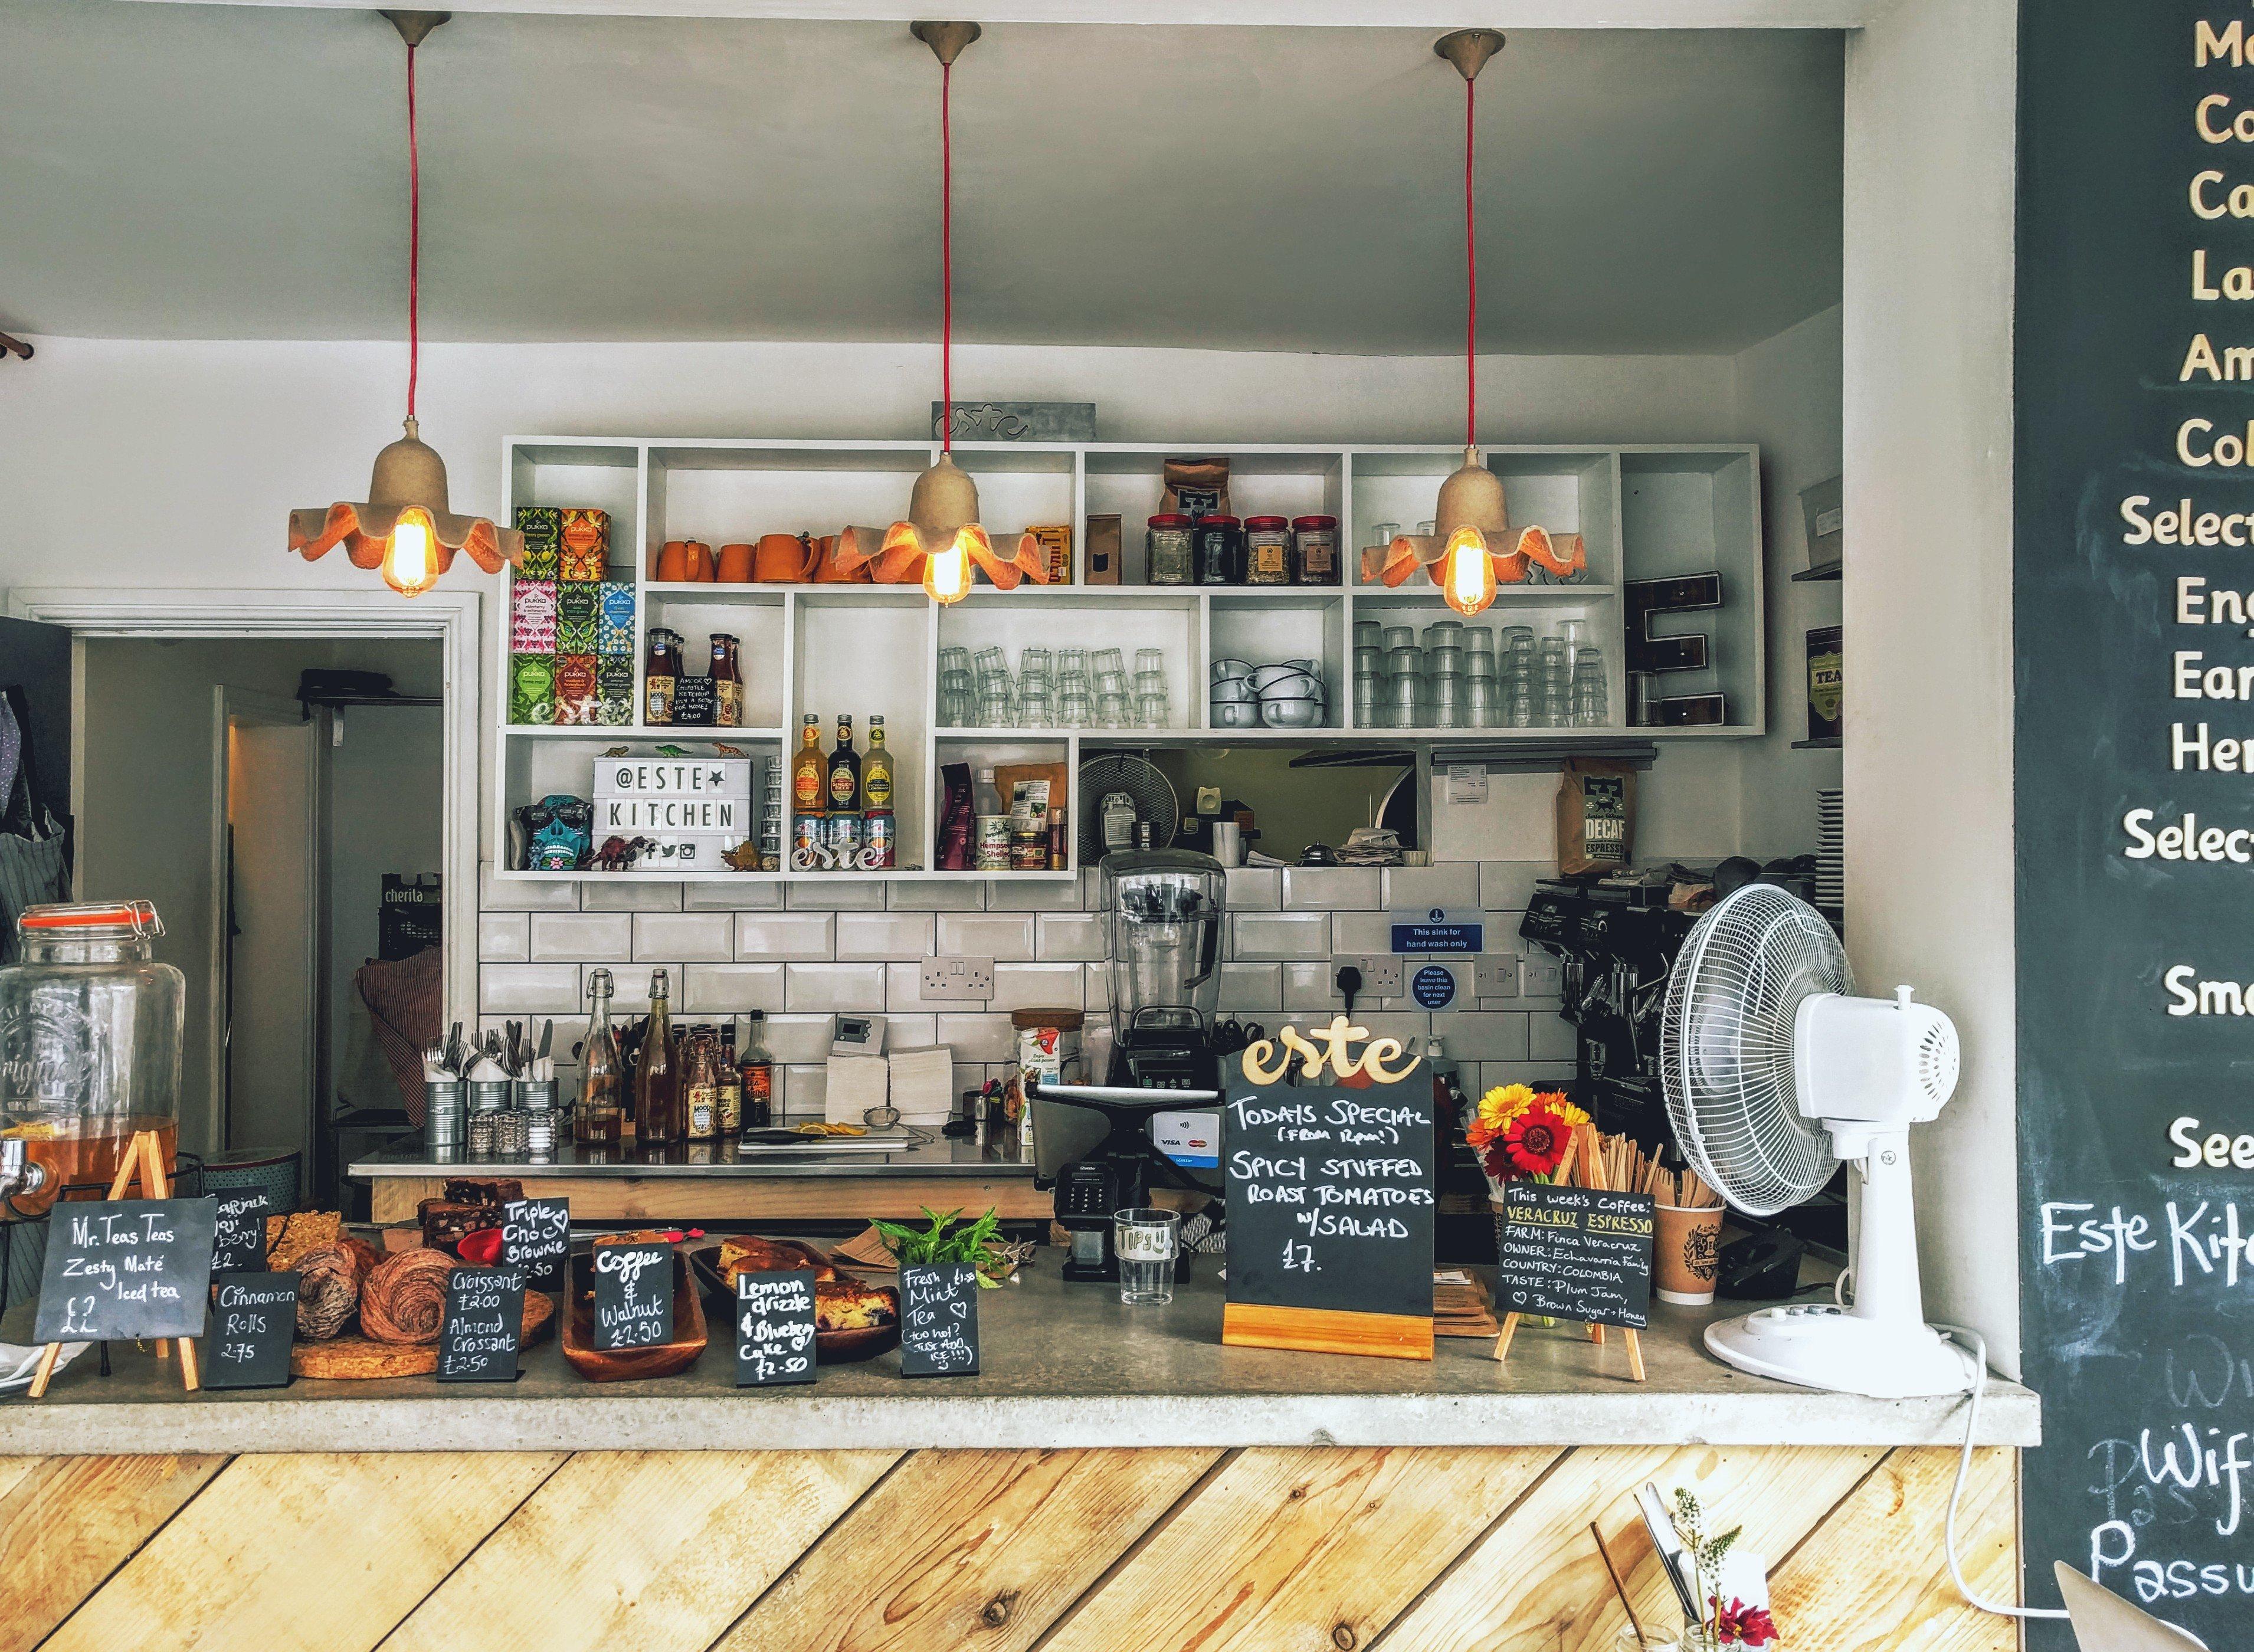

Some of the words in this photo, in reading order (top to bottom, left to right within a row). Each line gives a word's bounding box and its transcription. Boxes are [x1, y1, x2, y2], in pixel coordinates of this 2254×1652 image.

[2191, 250, 2254, 300] La
[2176, 576, 2254, 638] En
[1816, 669, 1843, 684] TEA
[610, 803, 732, 827] KITCHEN
[1585, 819, 1626, 840] DECAF
[2124, 808, 2254, 863] Selec
[791, 837, 885, 871] este
[1585, 844, 1624, 854] ESPRESSO
[1450, 940, 1467, 948] only
[1242, 1015, 1421, 1085] este
[1325, 1099, 1431, 1125] SPECIAL
[1229, 1150, 1306, 1181] SPICY
[1320, 1158, 1423, 1179] STUFFED
[1248, 1184, 1306, 1204] ROAST
[1313, 1185, 1434, 1205] TOMATOES
[1508, 1188, 1538, 1202] This
[1547, 1193, 1590, 1207] week's
[1597, 1197, 1651, 1214] Coffee:
[504, 1201, 555, 1230] Triple
[1506, 1206, 1578, 1227] VERACRUZ
[1587, 1214, 1653, 1234] ESPRESSO
[71, 1216, 100, 1248] Mr.
[99, 1214, 139, 1245] Teas
[140, 1214, 175, 1243] Teas
[218, 1218, 262, 1249] berry!
[502, 1225, 558, 1244] Choc
[1117, 1225, 1152, 1251] TIPS
[1505, 1225, 1545, 1241] FARM:
[1547, 1233, 1581, 1247] Finca
[1584, 1235, 1642, 1252] Veracruz
[2041, 1201, 2157, 1285] Este
[506, 1241, 566, 1263] Brownie
[1503, 1242, 1551, 1257] OWNER:
[1622, 1255, 1650, 1275] Family
[63, 1258, 116, 1290] Zesty
[124, 1254, 164, 1274] Maté
[597, 1250, 664, 1283] Coffee
[903, 1268, 941, 1288] Fresh
[1503, 1258, 1561, 1274] COUNTRY:
[1562, 1266, 1623, 1283] COLOMBIA
[117, 1281, 147, 1303] Iced
[152, 1281, 181, 1299] tea
[453, 1271, 524, 1295] Croissant
[738, 1274, 805, 1300] Lemon
[909, 1281, 959, 1306] Mint
[1554, 1280, 1588, 1296] Plum
[1590, 1286, 1628, 1304] Jam,
[221, 1284, 295, 1309] Cinnamon
[457, 1294, 500, 1311] £2.00
[751, 1294, 811, 1317] drizzle
[61, 1296, 99, 1334] £2
[601, 1297, 664, 1329] Walnut
[907, 1304, 936, 1328] Tea
[1532, 1294, 1572, 1312] Brown
[1576, 1301, 1611, 1320] Sugar
[1619, 1309, 1646, 1328] Honey
[226, 1314, 267, 1336] Rolls
[449, 1313, 503, 1335] Almond
[611, 1320, 662, 1348] £2.50
[932, 1322, 961, 1339] hot?
[740, 1342, 787, 1360] Cake
[444, 1355, 489, 1374] £2.50
